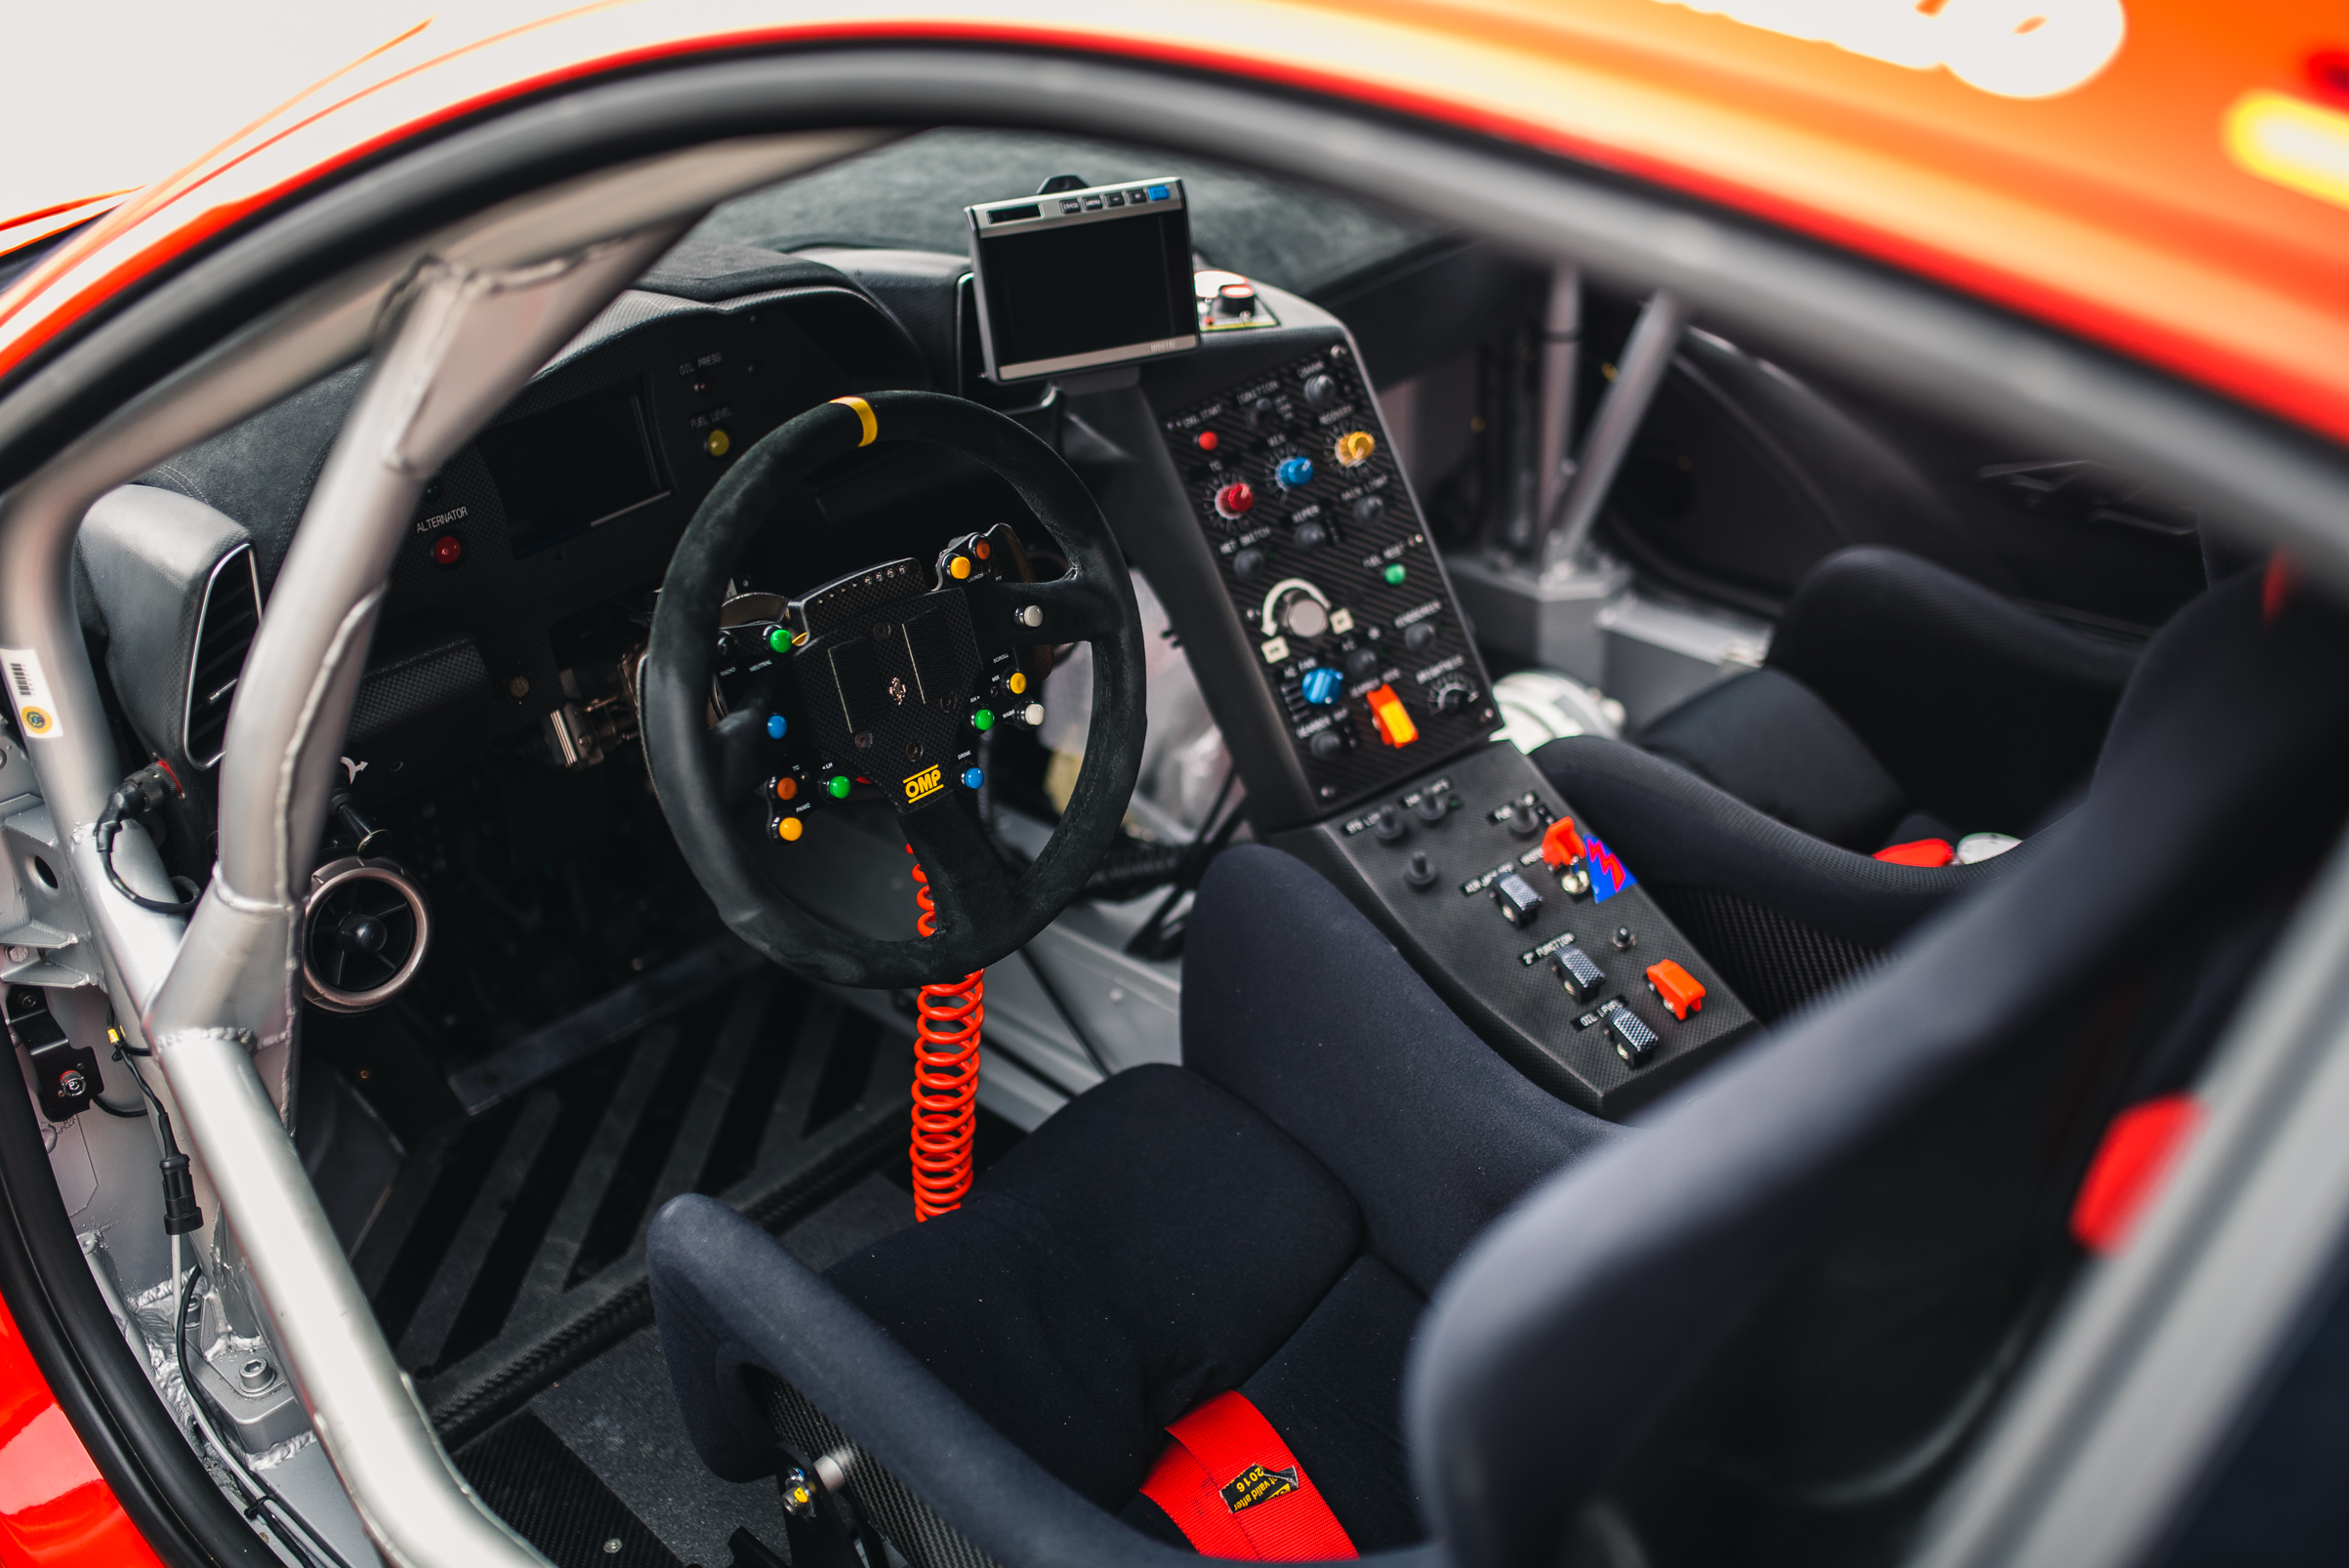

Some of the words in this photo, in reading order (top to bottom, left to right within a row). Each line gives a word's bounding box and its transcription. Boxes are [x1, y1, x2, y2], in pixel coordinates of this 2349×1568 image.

[680, 363, 694, 375] OIL
[697, 352, 721, 368] PRESS
[1236, 379, 1279, 404] IGNITION
[690, 416, 708, 429] FUEL
[711, 407, 732, 422] LEVEL
[417, 506, 468, 533] ALTERNATOR
[967, 572, 984, 583] LAUNCH
[749, 659, 772, 672] NEUTRAL
[993, 653, 1010, 664] SCROLL
[720, 666, 736, 677] RADIO
[1002, 709, 1015, 719] WASH
[957, 750, 971, 761] DRINK
[905, 769, 941, 798] OMP
[796, 803, 810, 813] PANIC
[1535, 932, 1575, 958] FUNCTION
[1580, 1012, 1599, 1026] OIL
[1597, 999, 1623, 1017] LEVEL
[1236, 1466, 1264, 1492] 2016
[1251, 1480, 1270, 1500] valid
[1233, 1494, 1252, 1511] after
